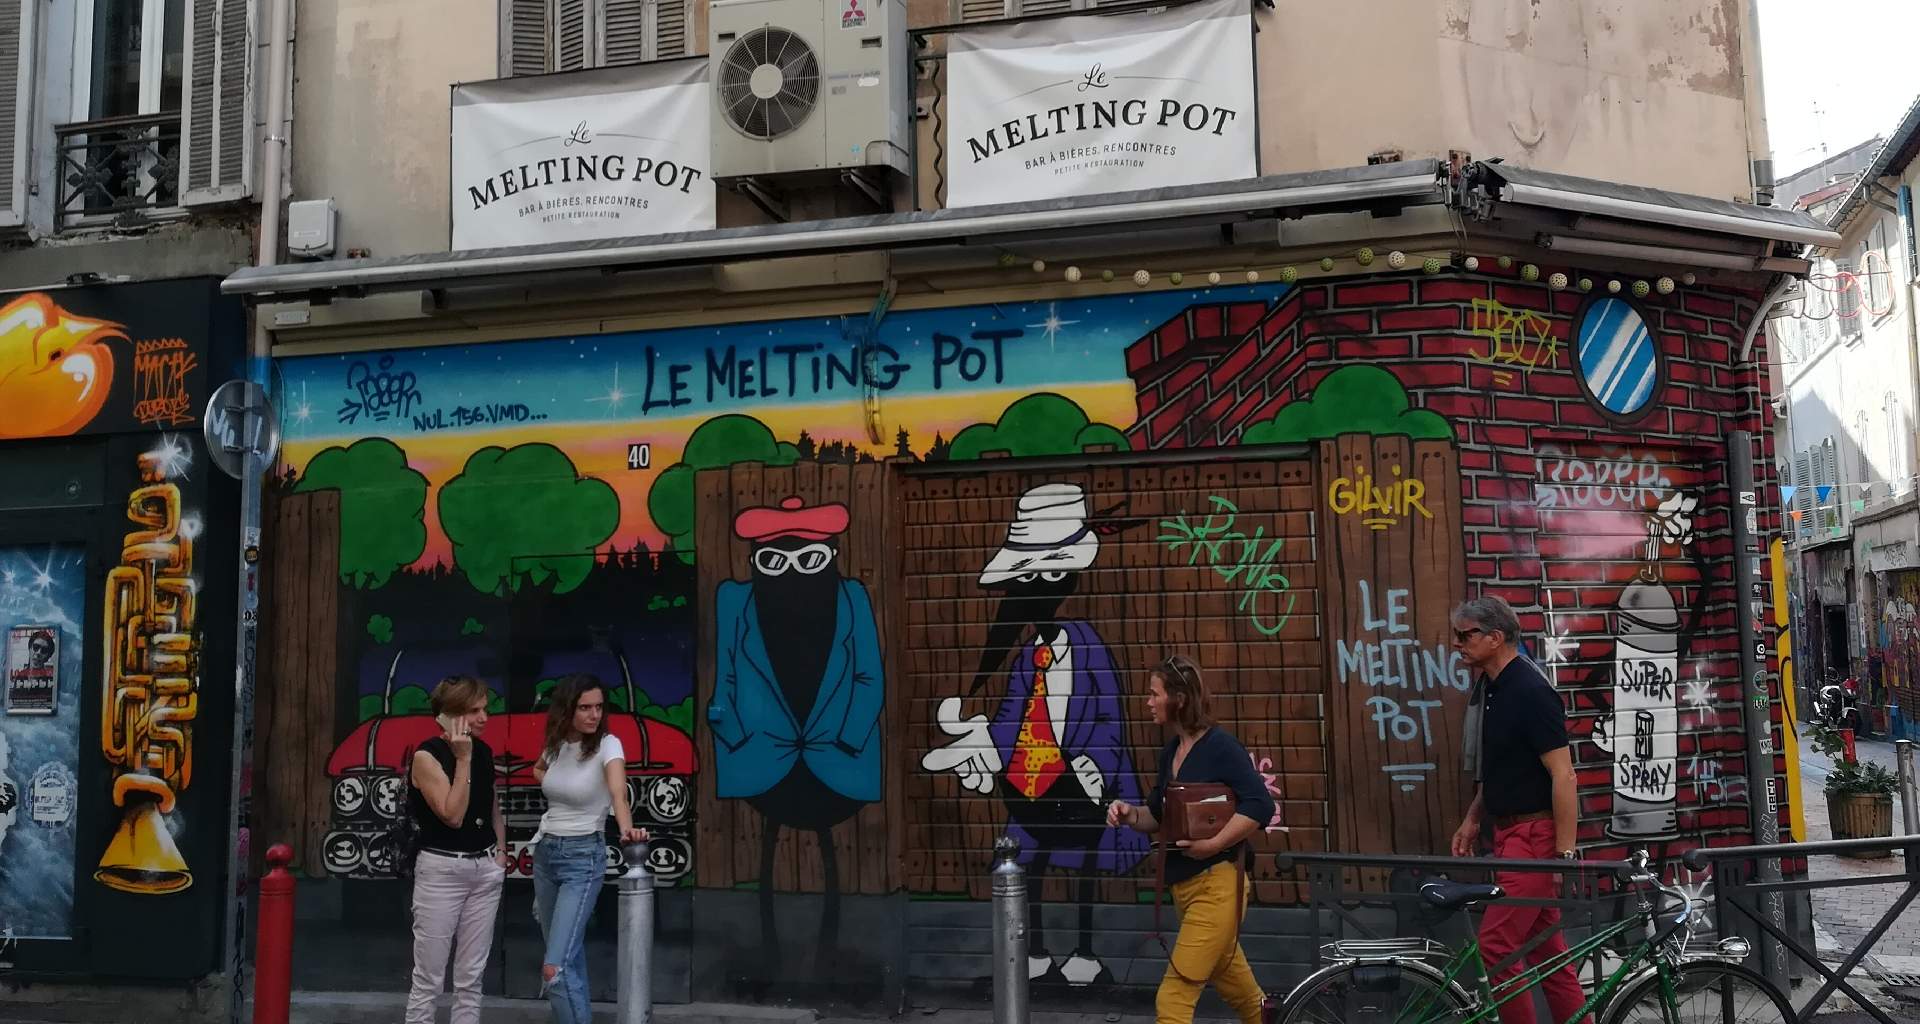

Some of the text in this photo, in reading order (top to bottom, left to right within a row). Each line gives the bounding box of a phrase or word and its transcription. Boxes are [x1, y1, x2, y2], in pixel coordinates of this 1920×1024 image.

[1078, 62, 1109, 92] Le
[564, 119, 591, 147] Le
[966, 99, 1236, 163] MELTING POT
[1025, 156, 1046, 170] BAR
[1103, 142, 1177, 156] RENCONTRES
[1084, 158, 1145, 168] RESTAURATION
[468, 155, 701, 210] MELTING POT
[518, 203, 536, 217] BAR
[586, 195, 649, 210] RENCONTRES
[568, 210, 620, 219] RESTAURATION
[642, 345, 692, 415] LE
[933, 328, 1023, 389] POT
[629, 445, 650, 468] 40
[1358, 579, 1410, 634] LE
[1620, 658, 1672, 702] SUPER
[1366, 695, 1442, 746] POT
[1619, 753, 1672, 796] SPRAY
